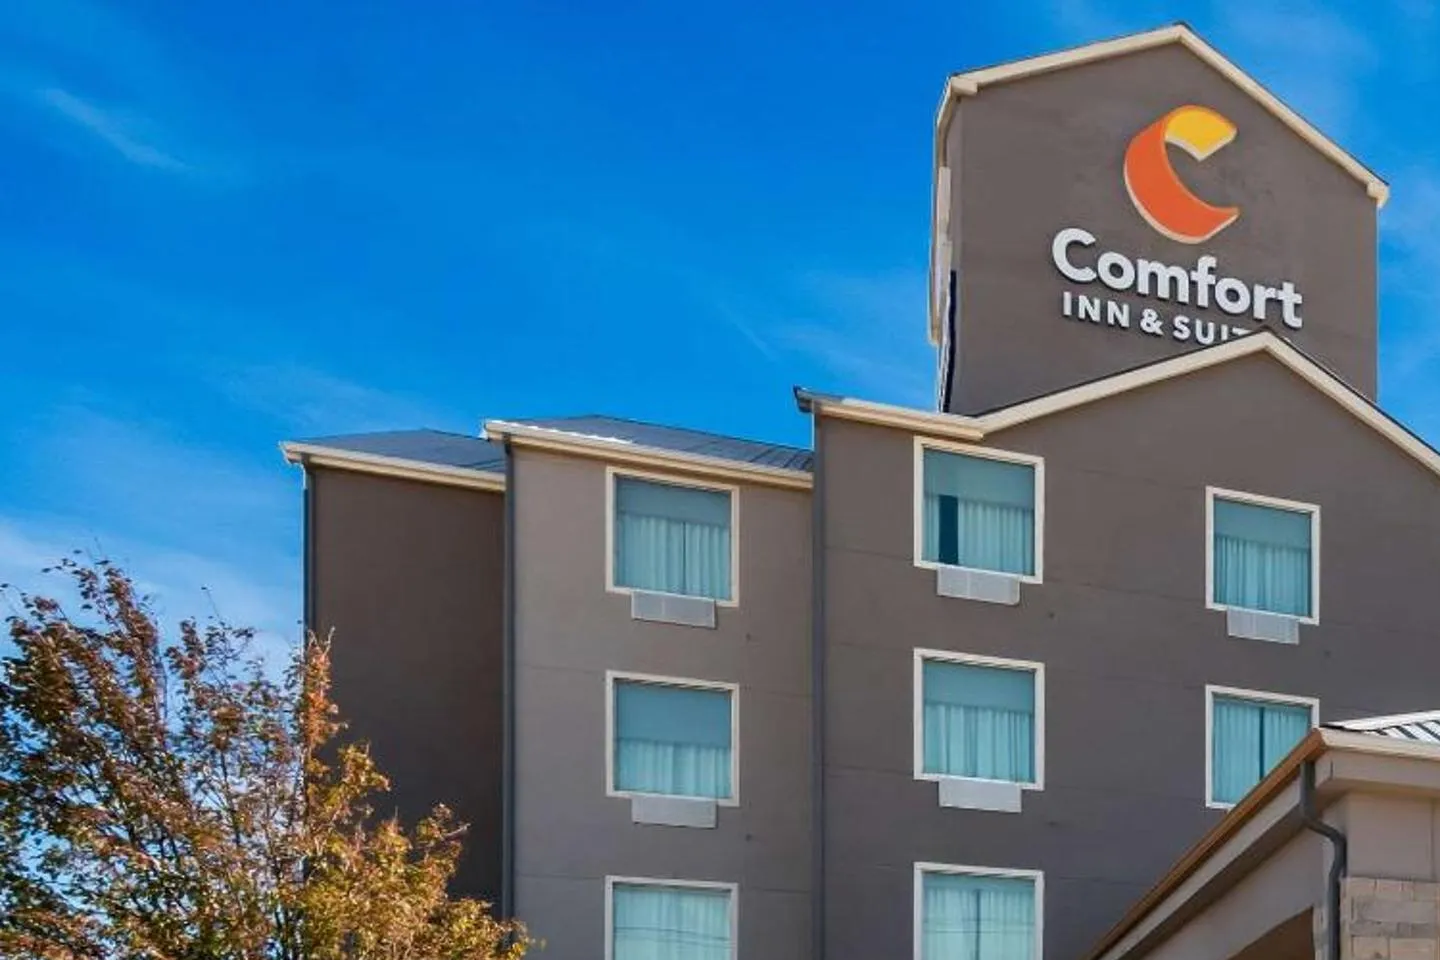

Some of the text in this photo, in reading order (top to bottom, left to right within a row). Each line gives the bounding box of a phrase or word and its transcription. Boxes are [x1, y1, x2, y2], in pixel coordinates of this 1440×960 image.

[1051, 227, 1303, 328] Comfort
[1062, 291, 1131, 328] INN
[1139, 308, 1164, 336] &
